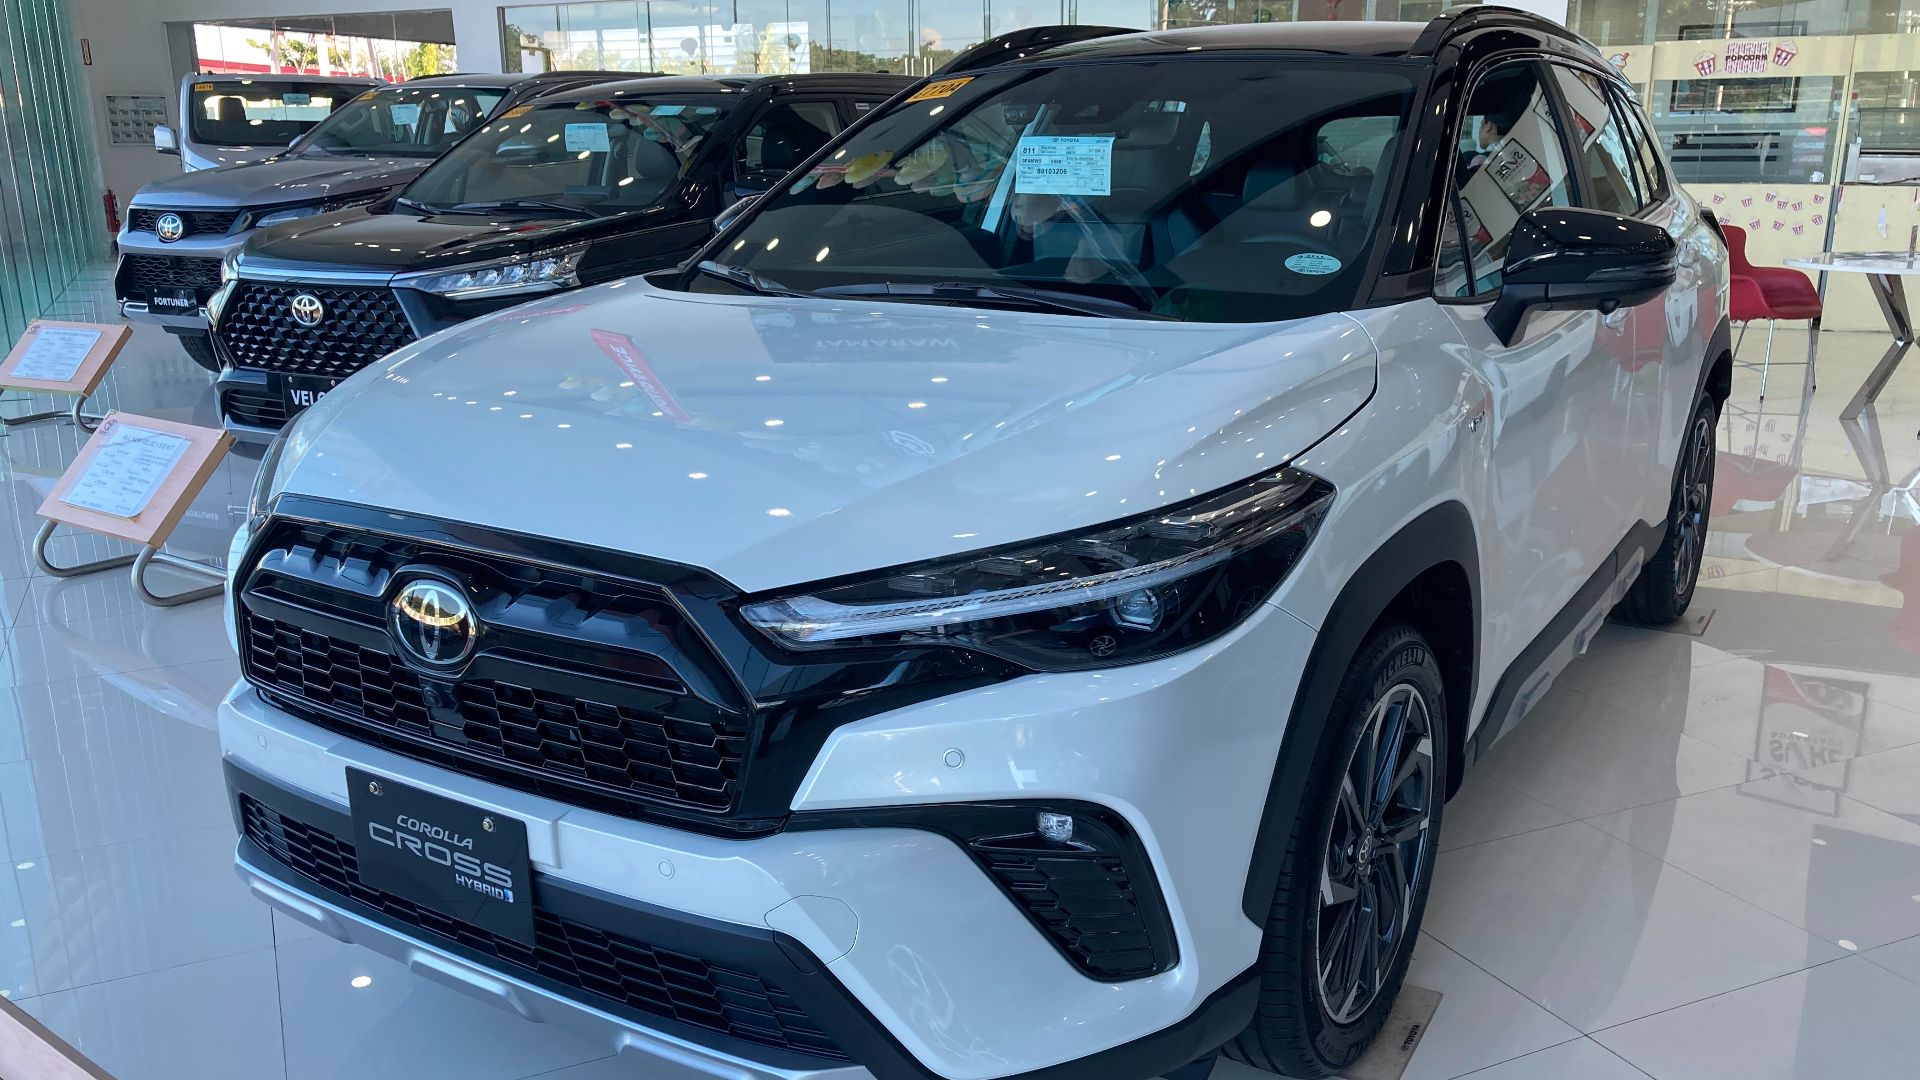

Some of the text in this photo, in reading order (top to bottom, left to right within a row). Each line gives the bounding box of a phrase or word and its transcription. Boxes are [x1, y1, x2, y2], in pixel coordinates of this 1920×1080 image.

[1725, 54, 1768, 62] POPCORN
[153, 296, 189, 308] FORTUNER
[396, 814, 473, 850] COROLLA
[368, 821, 513, 889] CROSS
[455, 873, 505, 901] HYBRID
[1403, 1023, 1421, 1046] TOYOTA
